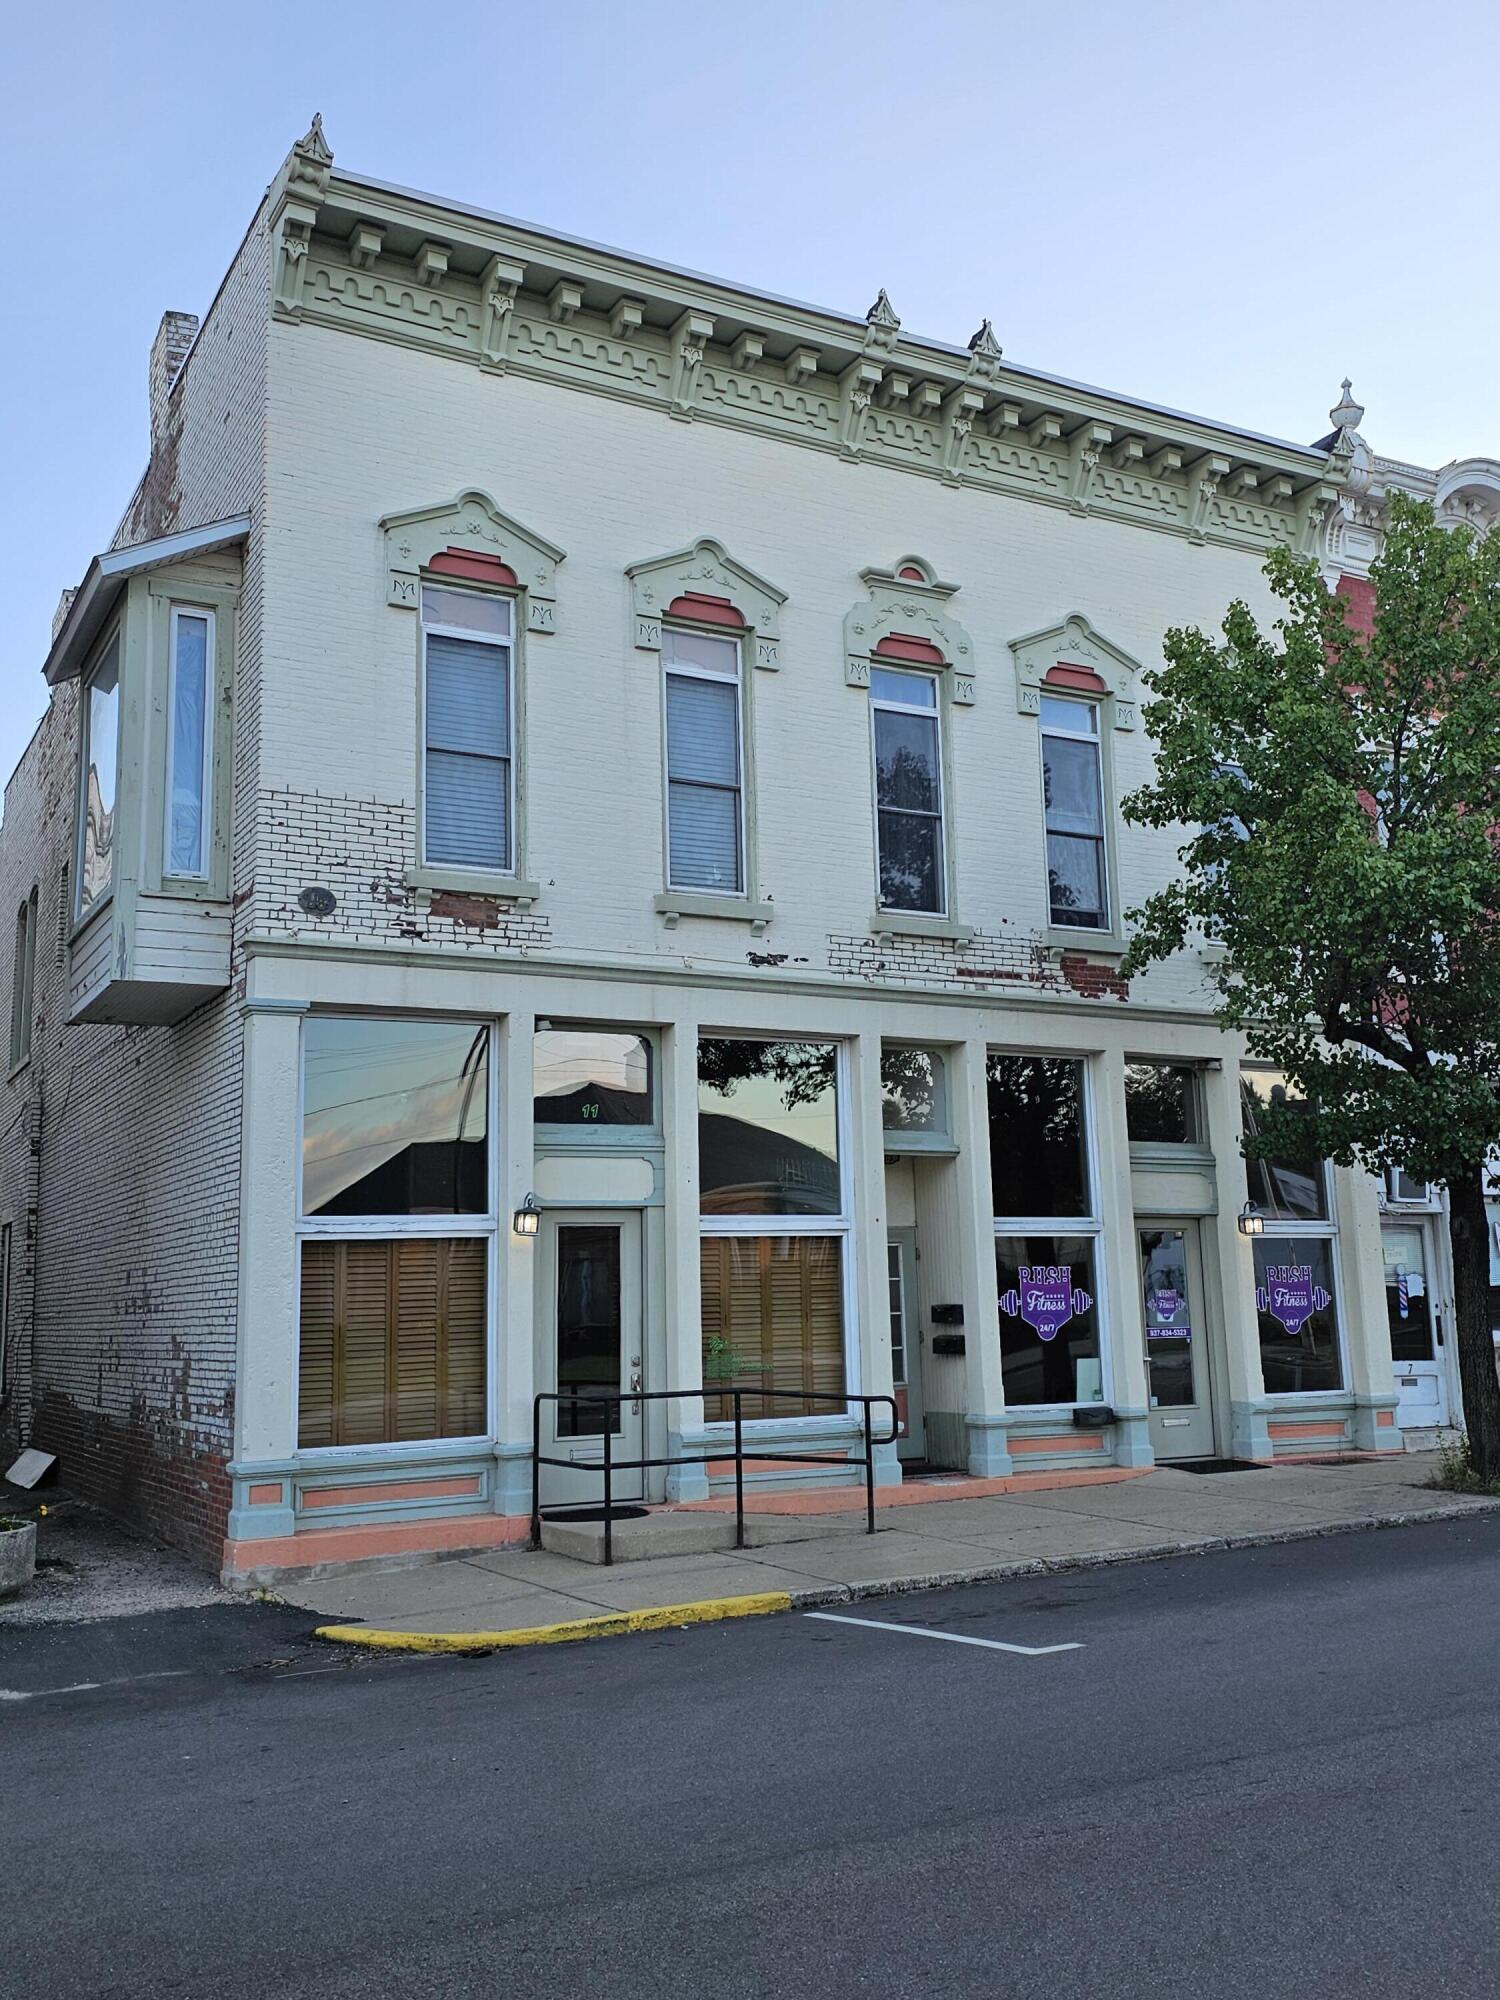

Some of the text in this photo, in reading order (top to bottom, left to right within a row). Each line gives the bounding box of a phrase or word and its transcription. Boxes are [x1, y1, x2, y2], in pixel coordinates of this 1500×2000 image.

[581, 1104, 600, 1118] 11
[1018, 1266, 1071, 1285] RUSH
[1266, 1265, 1311, 1283] RUSH
[1027, 1290, 1066, 1311] Fitness
[1274, 1288, 1308, 1307] Fitness
[1039, 1323, 1055, 1332] 24/7
[1285, 1319, 1299, 1327] 24/7
[1407, 1363, 1413, 1375] 7
